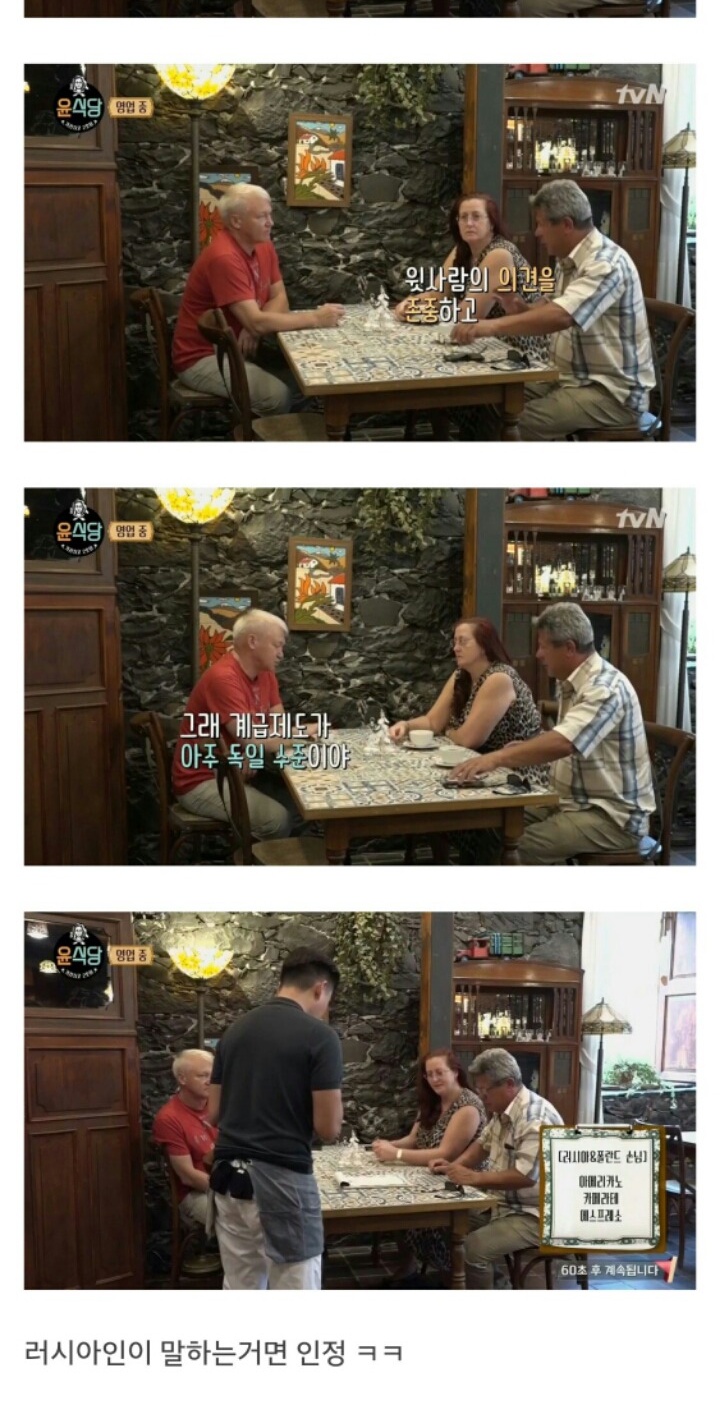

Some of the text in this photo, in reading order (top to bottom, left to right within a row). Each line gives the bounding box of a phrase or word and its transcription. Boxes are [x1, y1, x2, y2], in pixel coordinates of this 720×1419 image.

[25, 1339, 404, 1368] 러시아인이 말하는거면 인정 ㅋㅋ
